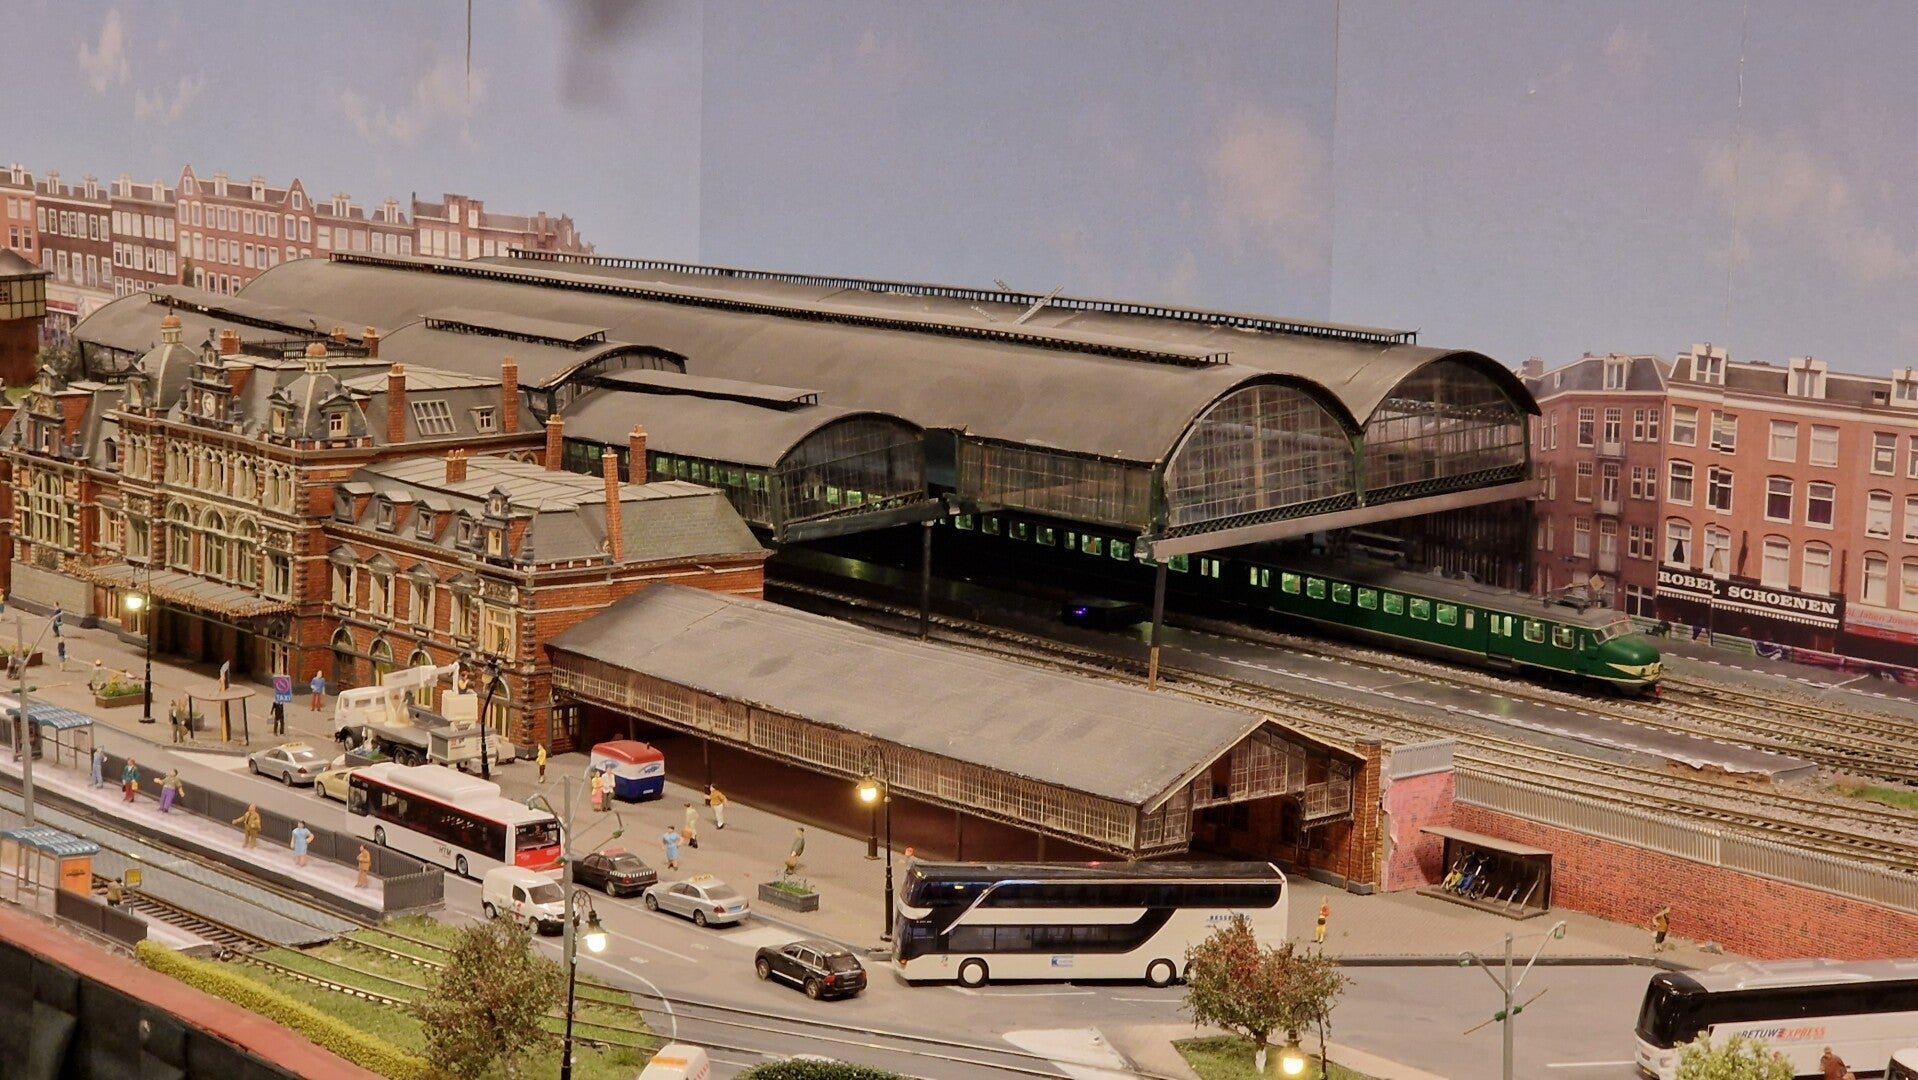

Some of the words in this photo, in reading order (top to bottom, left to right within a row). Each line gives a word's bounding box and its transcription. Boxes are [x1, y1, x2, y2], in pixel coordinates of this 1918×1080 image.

[1659, 571, 1720, 595] ROBEL
[1728, 586, 1836, 615] SCHOENEN
[276, 694, 291, 702] TAXI
[438, 845, 451, 856] HTM
